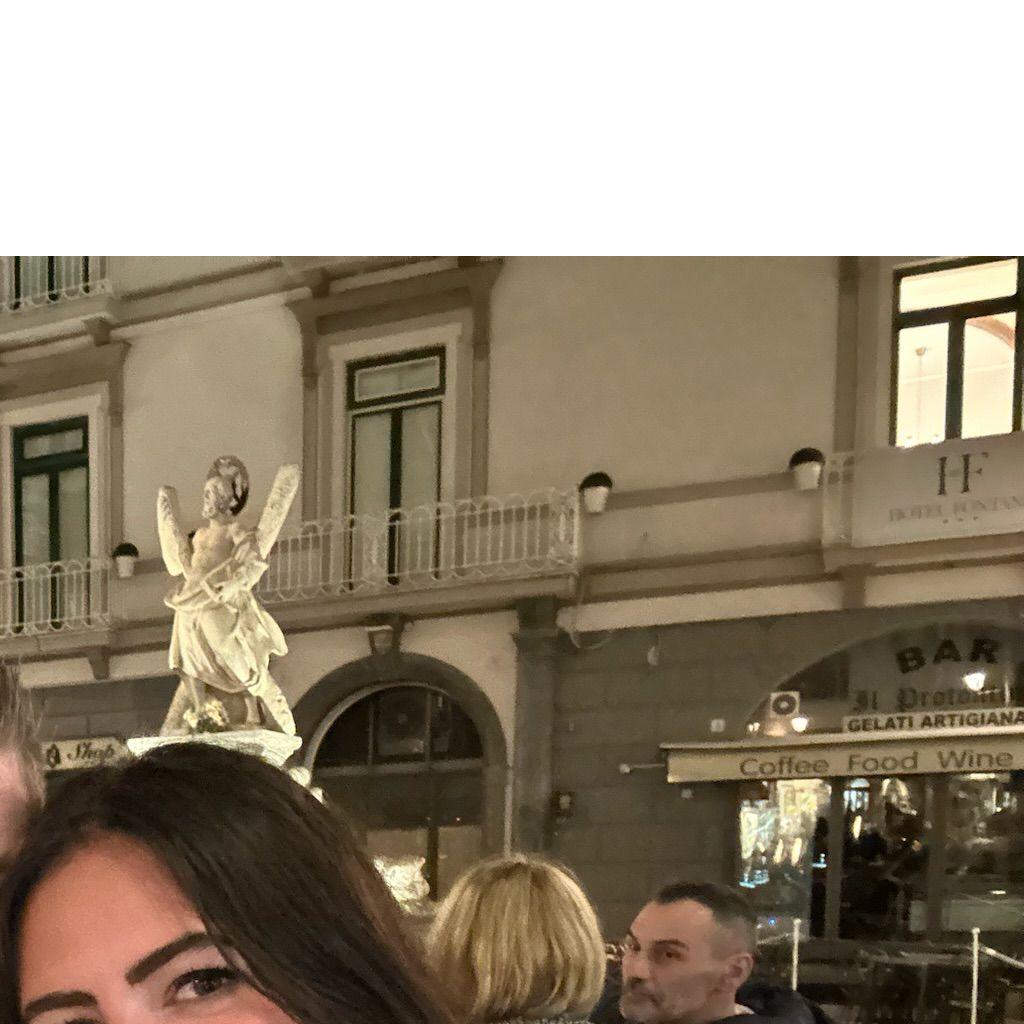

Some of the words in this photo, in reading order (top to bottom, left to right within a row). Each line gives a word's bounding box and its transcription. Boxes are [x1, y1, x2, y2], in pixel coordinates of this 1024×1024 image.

[896, 638, 1000, 674] BAR
[847, 715, 914, 733] GELATI
[738, 756, 830, 778] Coffee
[847, 751, 919, 773] Food
[936, 749, 1015, 770] Wine
